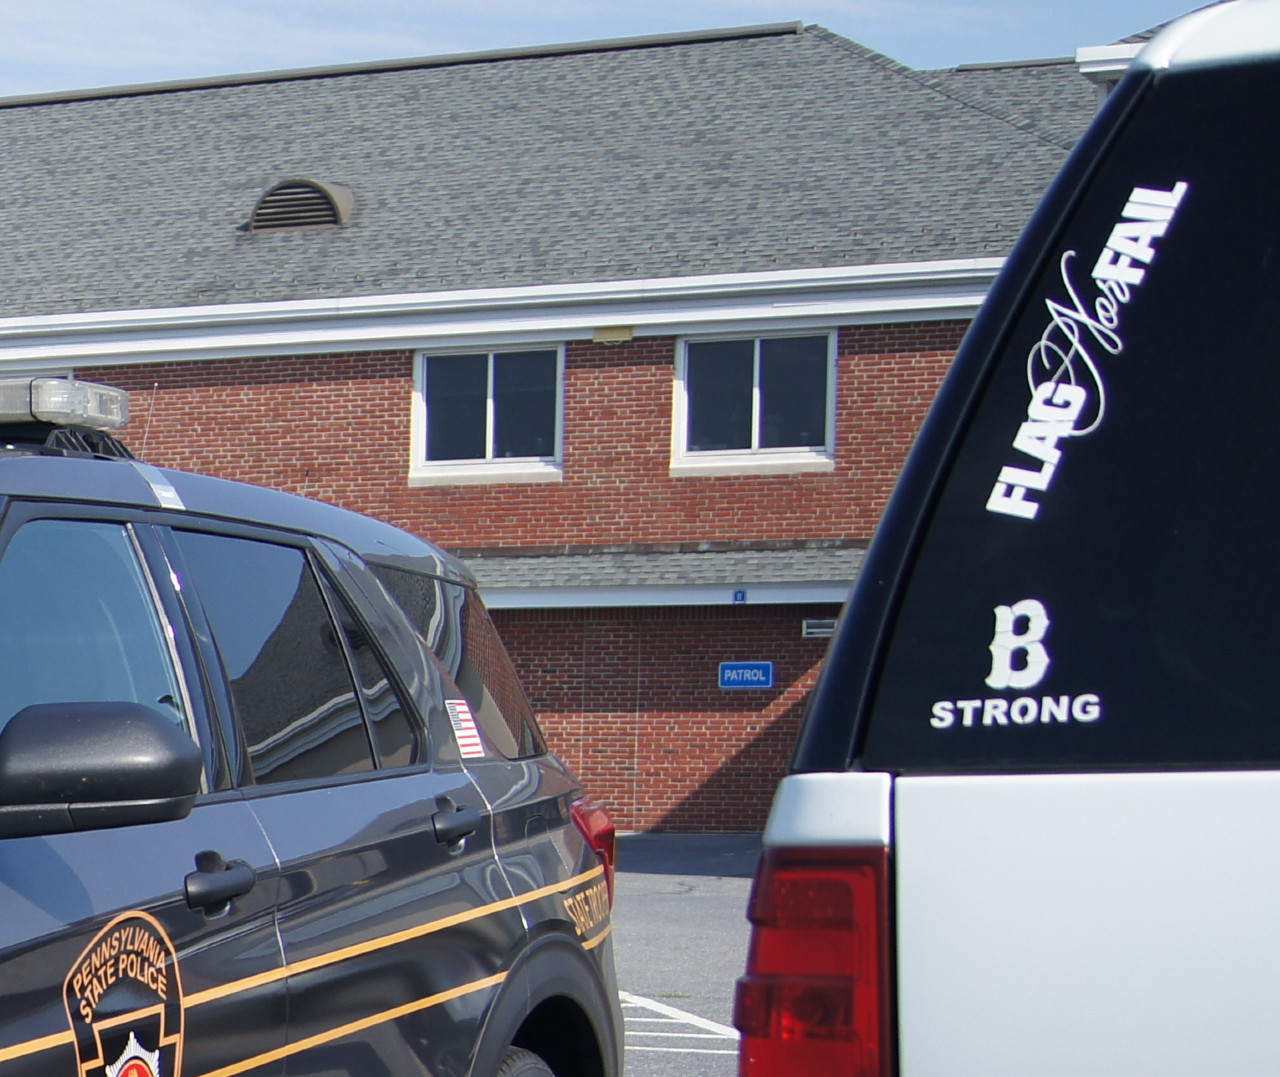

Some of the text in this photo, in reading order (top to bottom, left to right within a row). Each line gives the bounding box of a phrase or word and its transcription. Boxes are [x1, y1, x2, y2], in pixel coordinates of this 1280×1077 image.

[1091, 181, 1188, 285] FAIL
[986, 380, 1087, 520] FLAG
[724, 669, 767, 681] PATROL
[985, 599, 1049, 689] B
[930, 694, 1101, 728] STRONG
[73, 926, 167, 999] PENNSYLVANIA
[80, 953, 168, 1024] STATE POLICE
